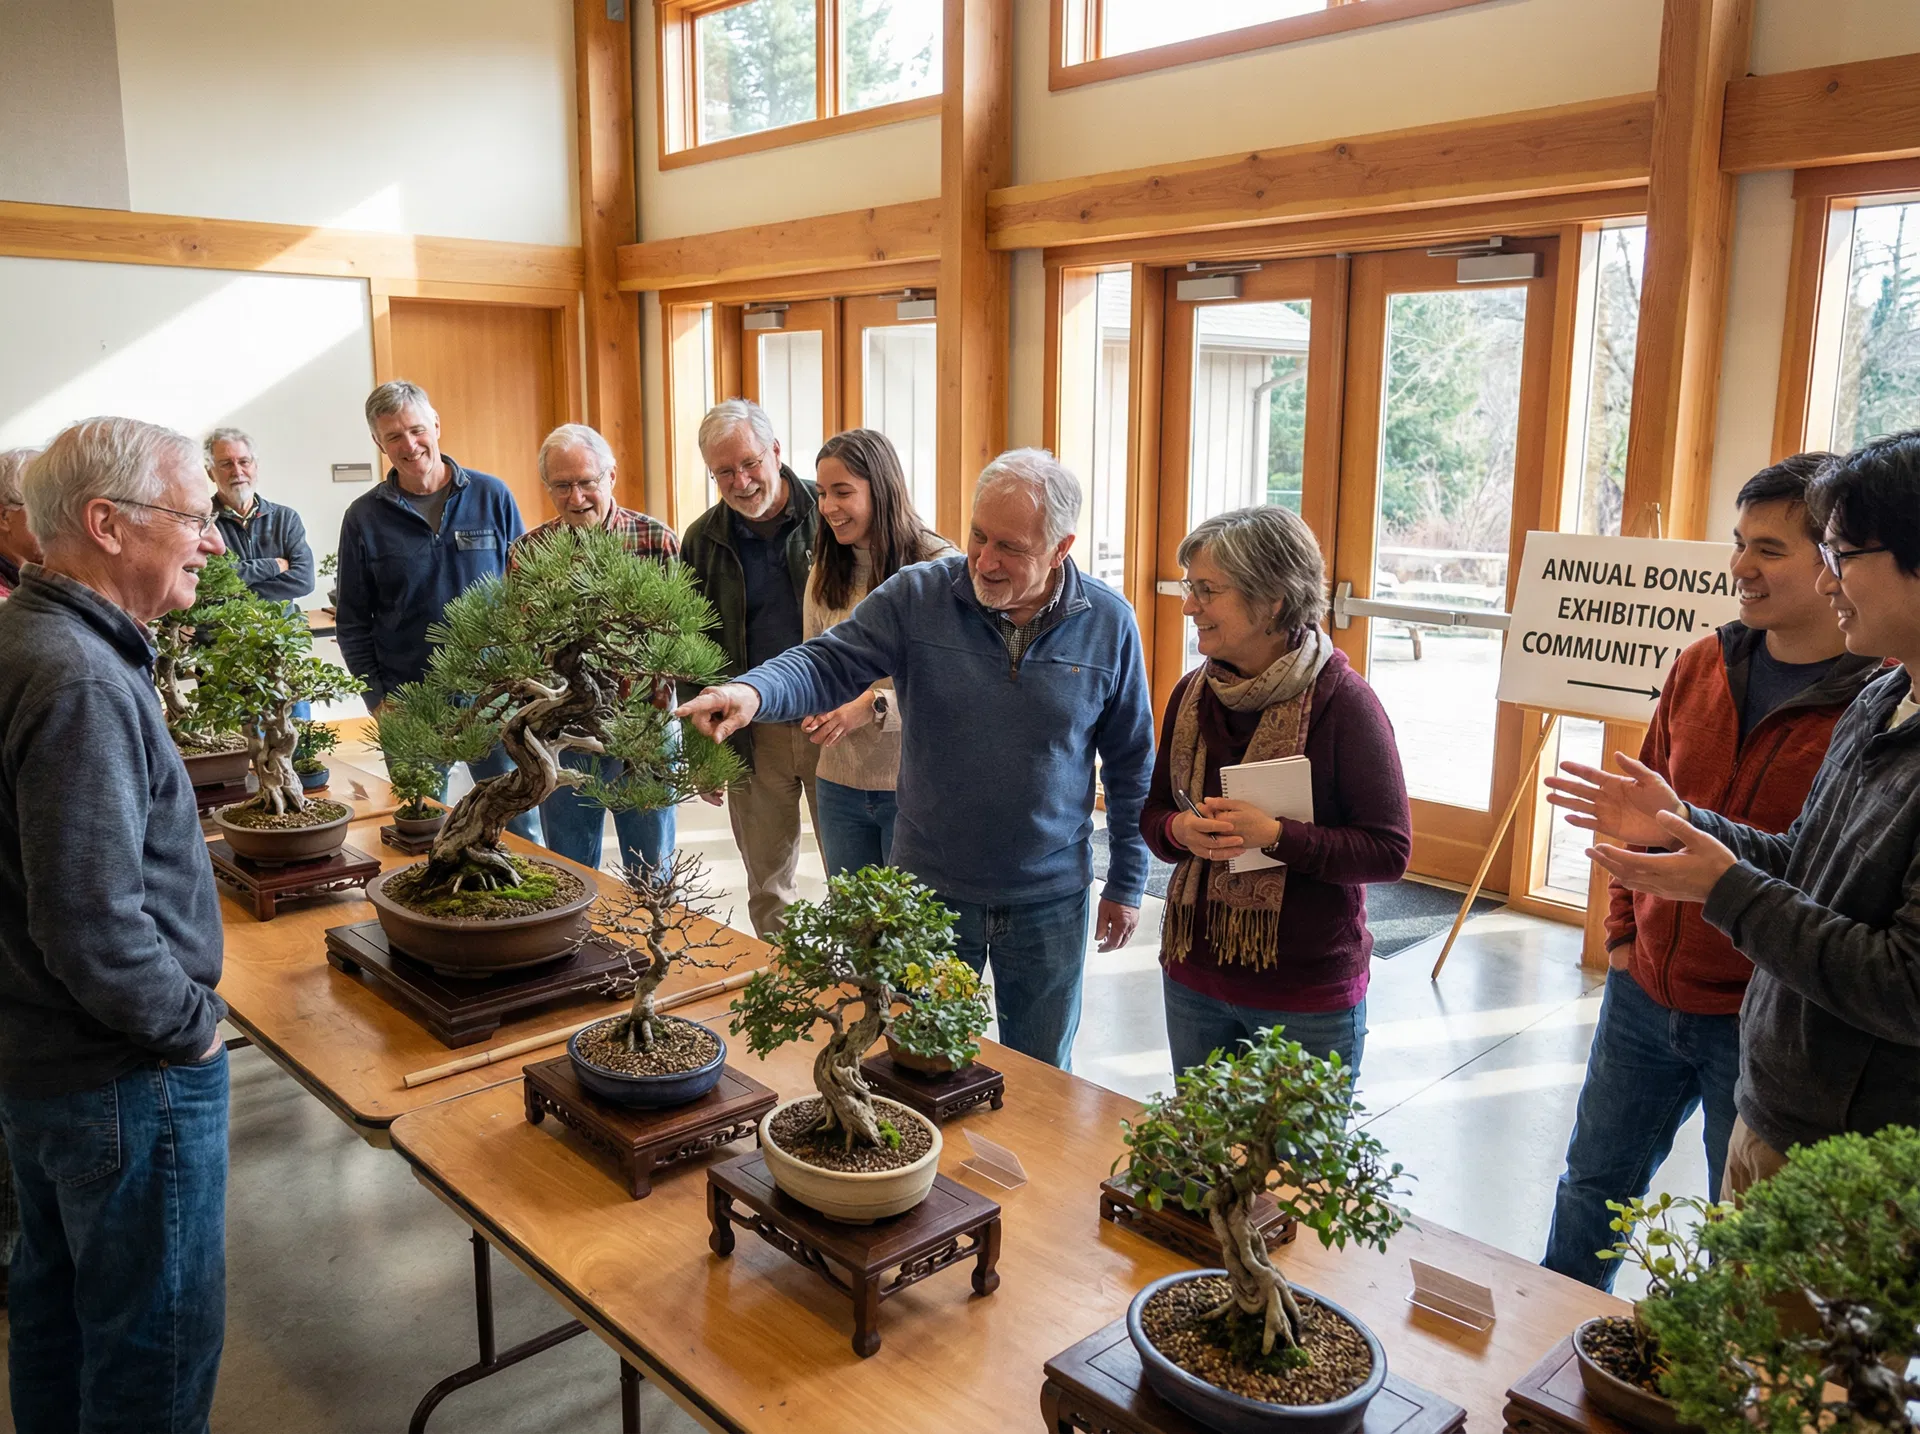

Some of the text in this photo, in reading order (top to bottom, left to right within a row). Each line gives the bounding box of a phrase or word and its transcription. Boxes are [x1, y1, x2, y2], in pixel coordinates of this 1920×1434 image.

[1541, 558, 1637, 588] ANNUAL
[1557, 596, 1696, 633] EXHIBITION
[1522, 630, 1669, 669] COMMUNITY
